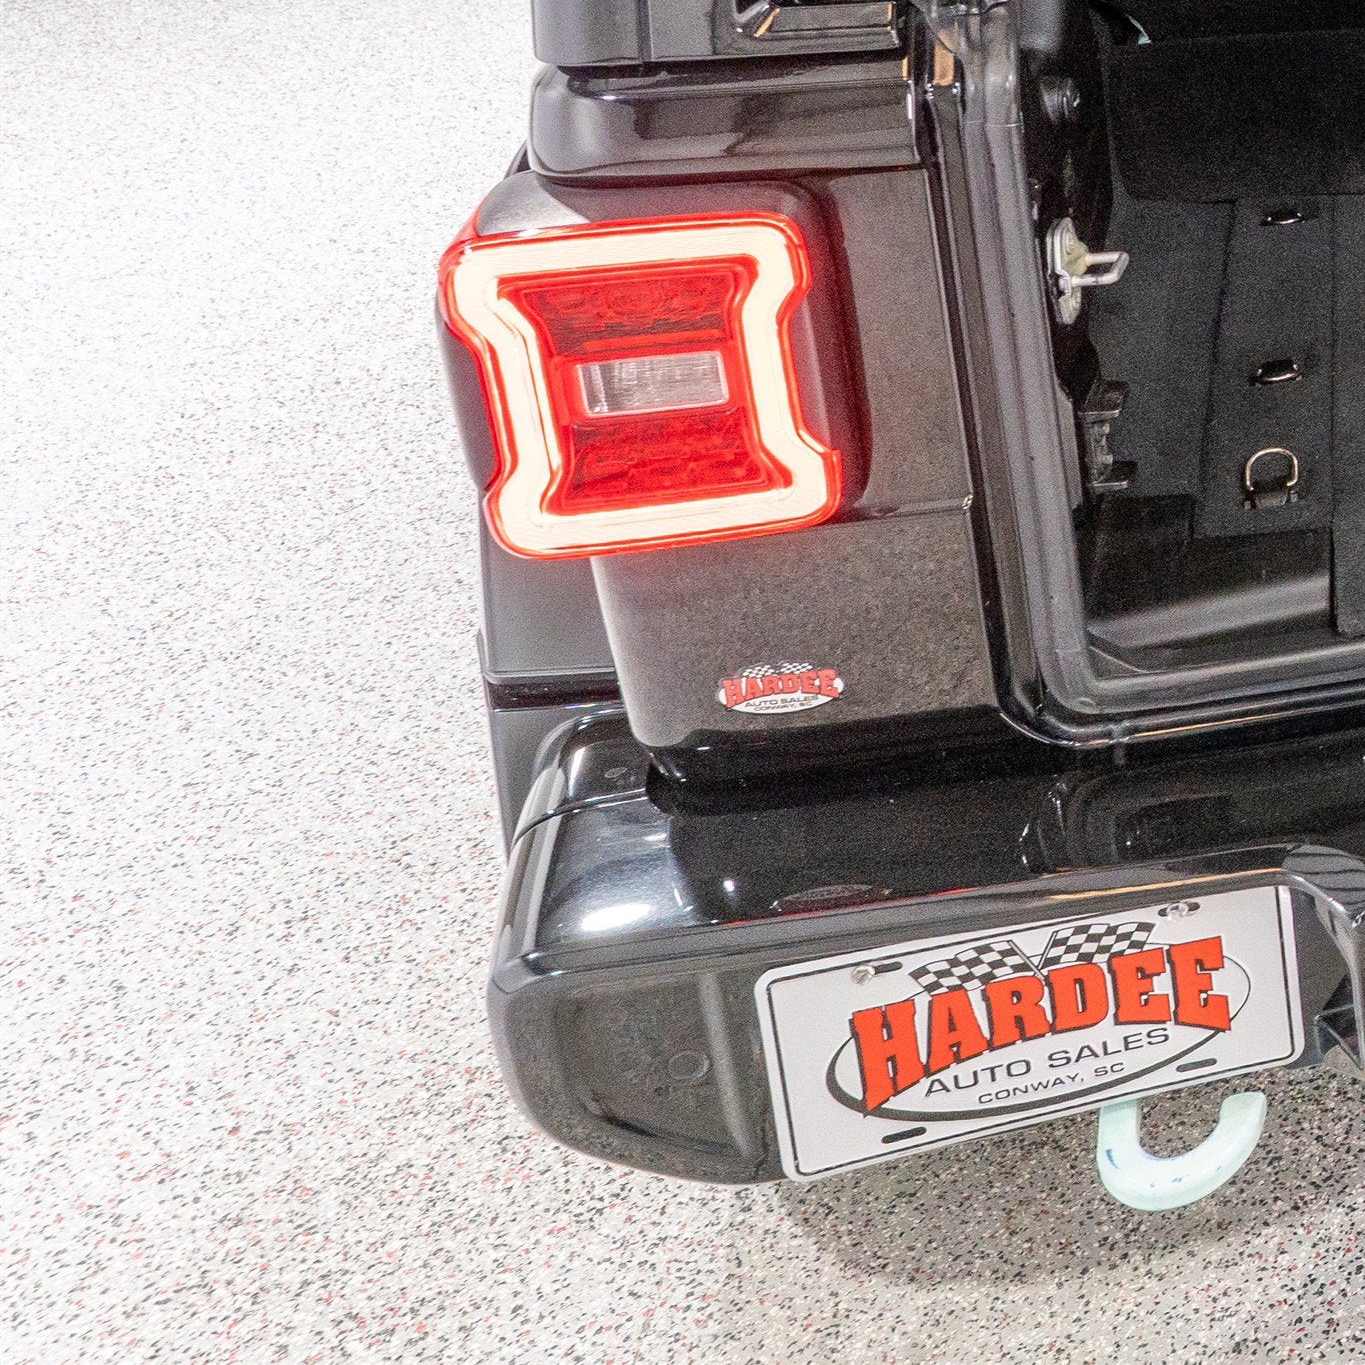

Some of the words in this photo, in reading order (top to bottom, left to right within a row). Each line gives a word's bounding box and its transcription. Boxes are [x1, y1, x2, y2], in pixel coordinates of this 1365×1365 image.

[722, 669, 839, 709] HARDEE
[850, 936, 1231, 1113] HARDEE
[924, 1058, 1032, 1098] AUTO
[1047, 1027, 1170, 1068] SALES
[978, 1072, 1085, 1105] CONWAY,
[1094, 1062, 1126, 1077] SC
